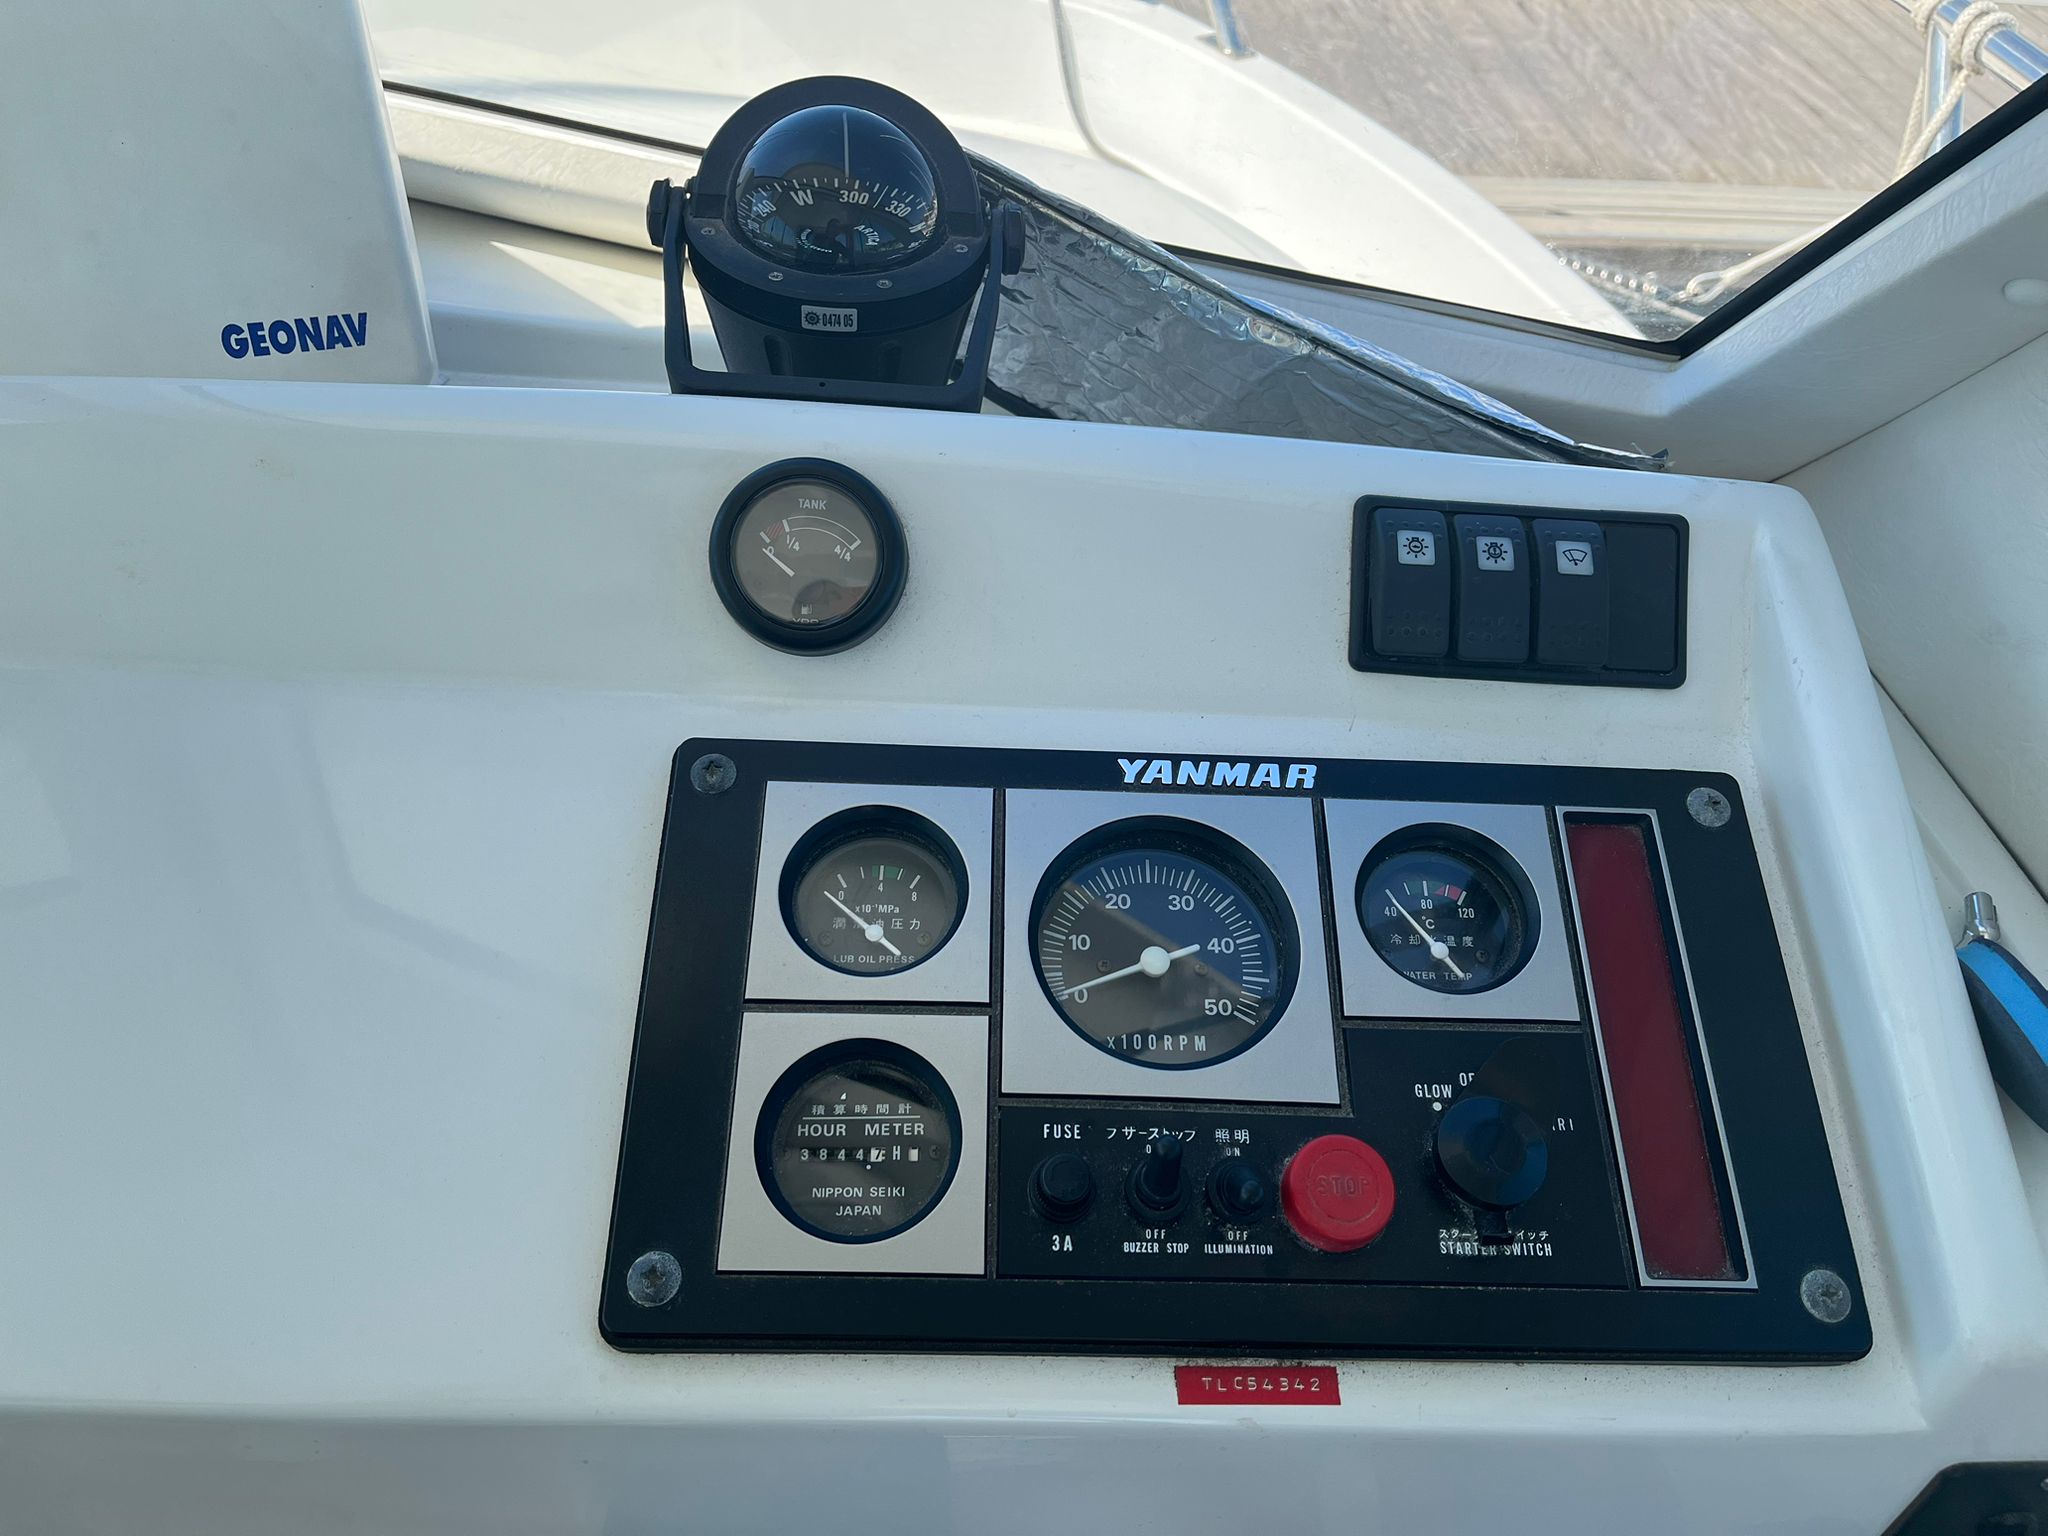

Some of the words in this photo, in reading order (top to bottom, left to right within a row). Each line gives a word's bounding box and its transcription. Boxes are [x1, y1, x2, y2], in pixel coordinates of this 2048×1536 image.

[789, 189, 814, 206] W
[839, 190, 869, 205] 300
[753, 200, 777, 217] 240
[885, 200, 912, 218] 330
[822, 312, 842, 327] 0474
[843, 313, 854, 328] 05
[221, 312, 368, 359] GEONAV
[798, 498, 827, 510] TANK
[834, 544, 852, 562] 4/4
[1117, 758, 1318, 789] YANMAR
[877, 881, 884, 893] 4
[838, 890, 845, 901] 0
[911, 891, 917, 902] 8
[1104, 894, 1131, 910] 20
[1167, 895, 1195, 911] 30
[1384, 906, 1397, 917] 40
[1420, 899, 1433, 909] 80
[1458, 908, 1475, 918] 120
[1069, 935, 1091, 951] 10
[1206, 938, 1235, 954] 40
[833, 955, 855, 963] LUB
[858, 955, 876, 964] OIL
[879, 955, 915, 964] PRESS
[1074, 989, 1088, 1004] 0
[1204, 1000, 1233, 1016] 50
[1459, 1072, 1475, 1087] OF
[1415, 1083, 1453, 1099] GLOW
[797, 1124, 847, 1137] HOUR
[864, 1123, 925, 1136] METER
[1043, 1123, 1082, 1140] FUSE
[1215, 1128, 1250, 1144] 照明
[1225, 1147, 1241, 1157] ON
[812, 1187, 863, 1198] NIPPON
[870, 1187, 905, 1197] SEIKI
[1316, 1175, 1370, 1196] STOP
[835, 1205, 882, 1216] JAPAN
[1145, 1229, 1166, 1239] OFF
[1227, 1231, 1249, 1241] OFF
[1123, 1242, 1159, 1253] BUZZER
[1167, 1243, 1189, 1253] STOP
[1204, 1244, 1273, 1255] ILLUMINATION
[1439, 1242, 1498, 1256] STARTER
[1504, 1243, 1553, 1256] SWITCH
